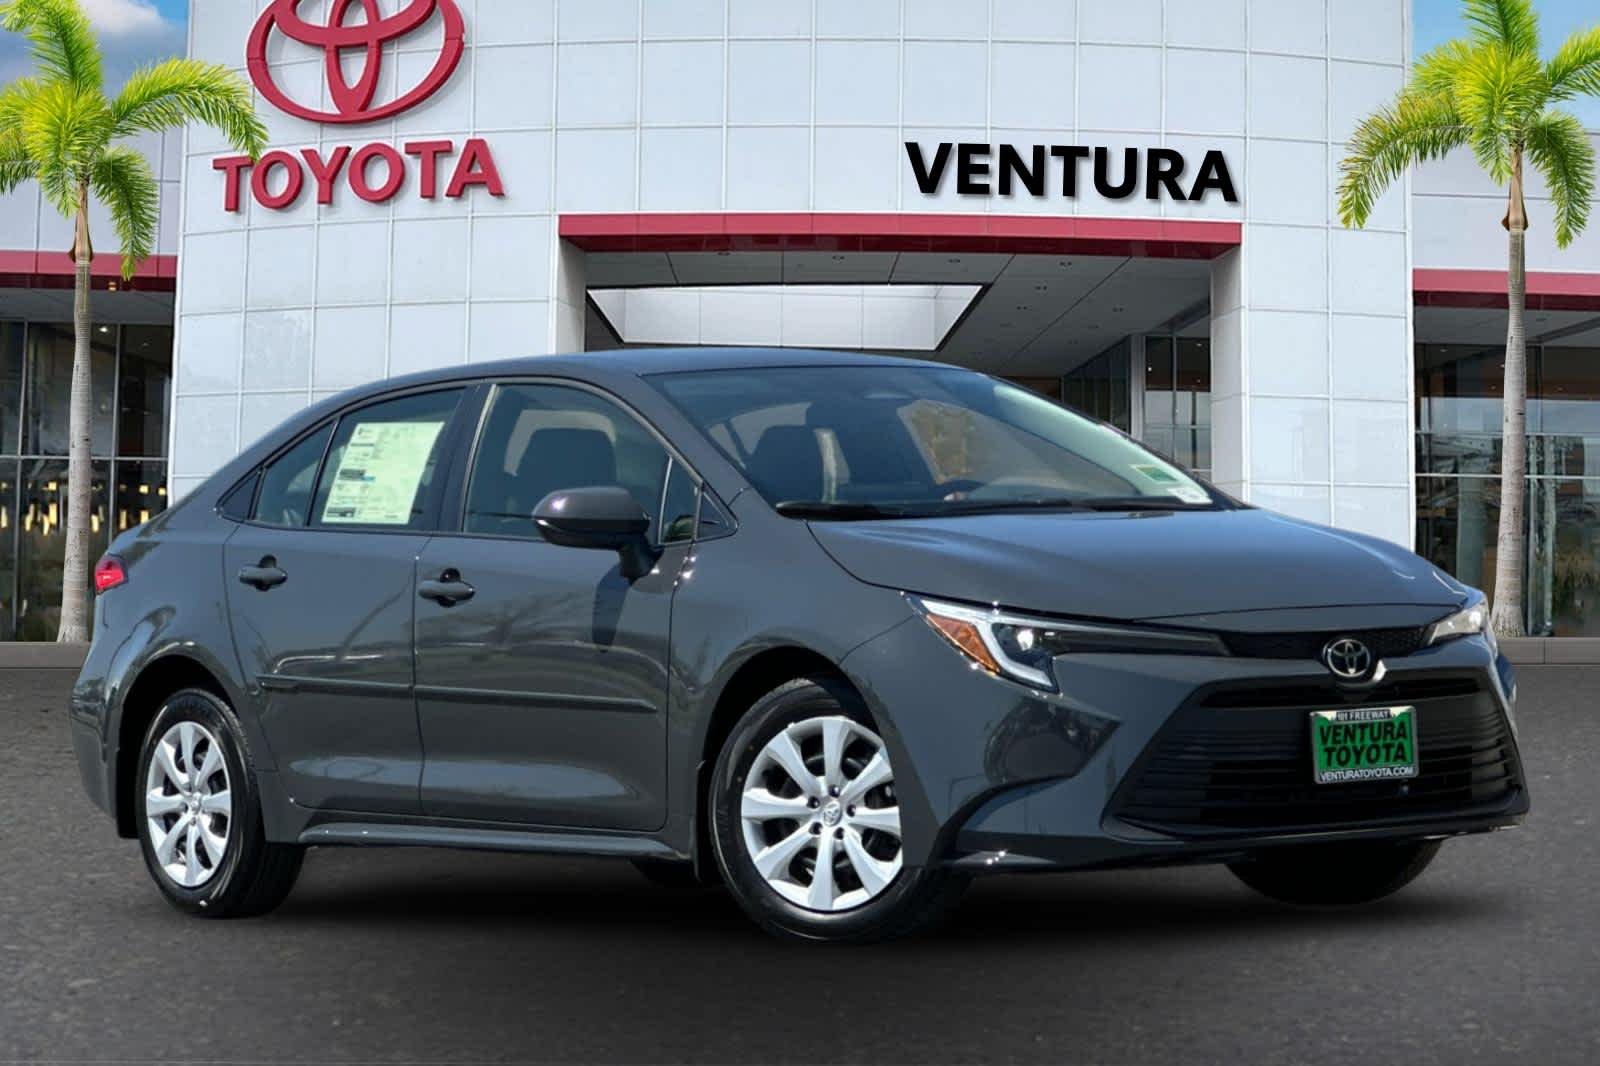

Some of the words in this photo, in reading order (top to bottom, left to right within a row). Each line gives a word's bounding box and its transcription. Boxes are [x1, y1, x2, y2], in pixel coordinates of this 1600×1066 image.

[212, 138, 505, 213] TOYOTA
[904, 142, 1239, 202] VENTURA
[1350, 710, 1388, 721] FREEWAY
[1319, 721, 1407, 745] VENTURA
[1324, 743, 1407, 767] TOYOTA
[1319, 766, 1413, 783] VENTURATOYOTA.COM
